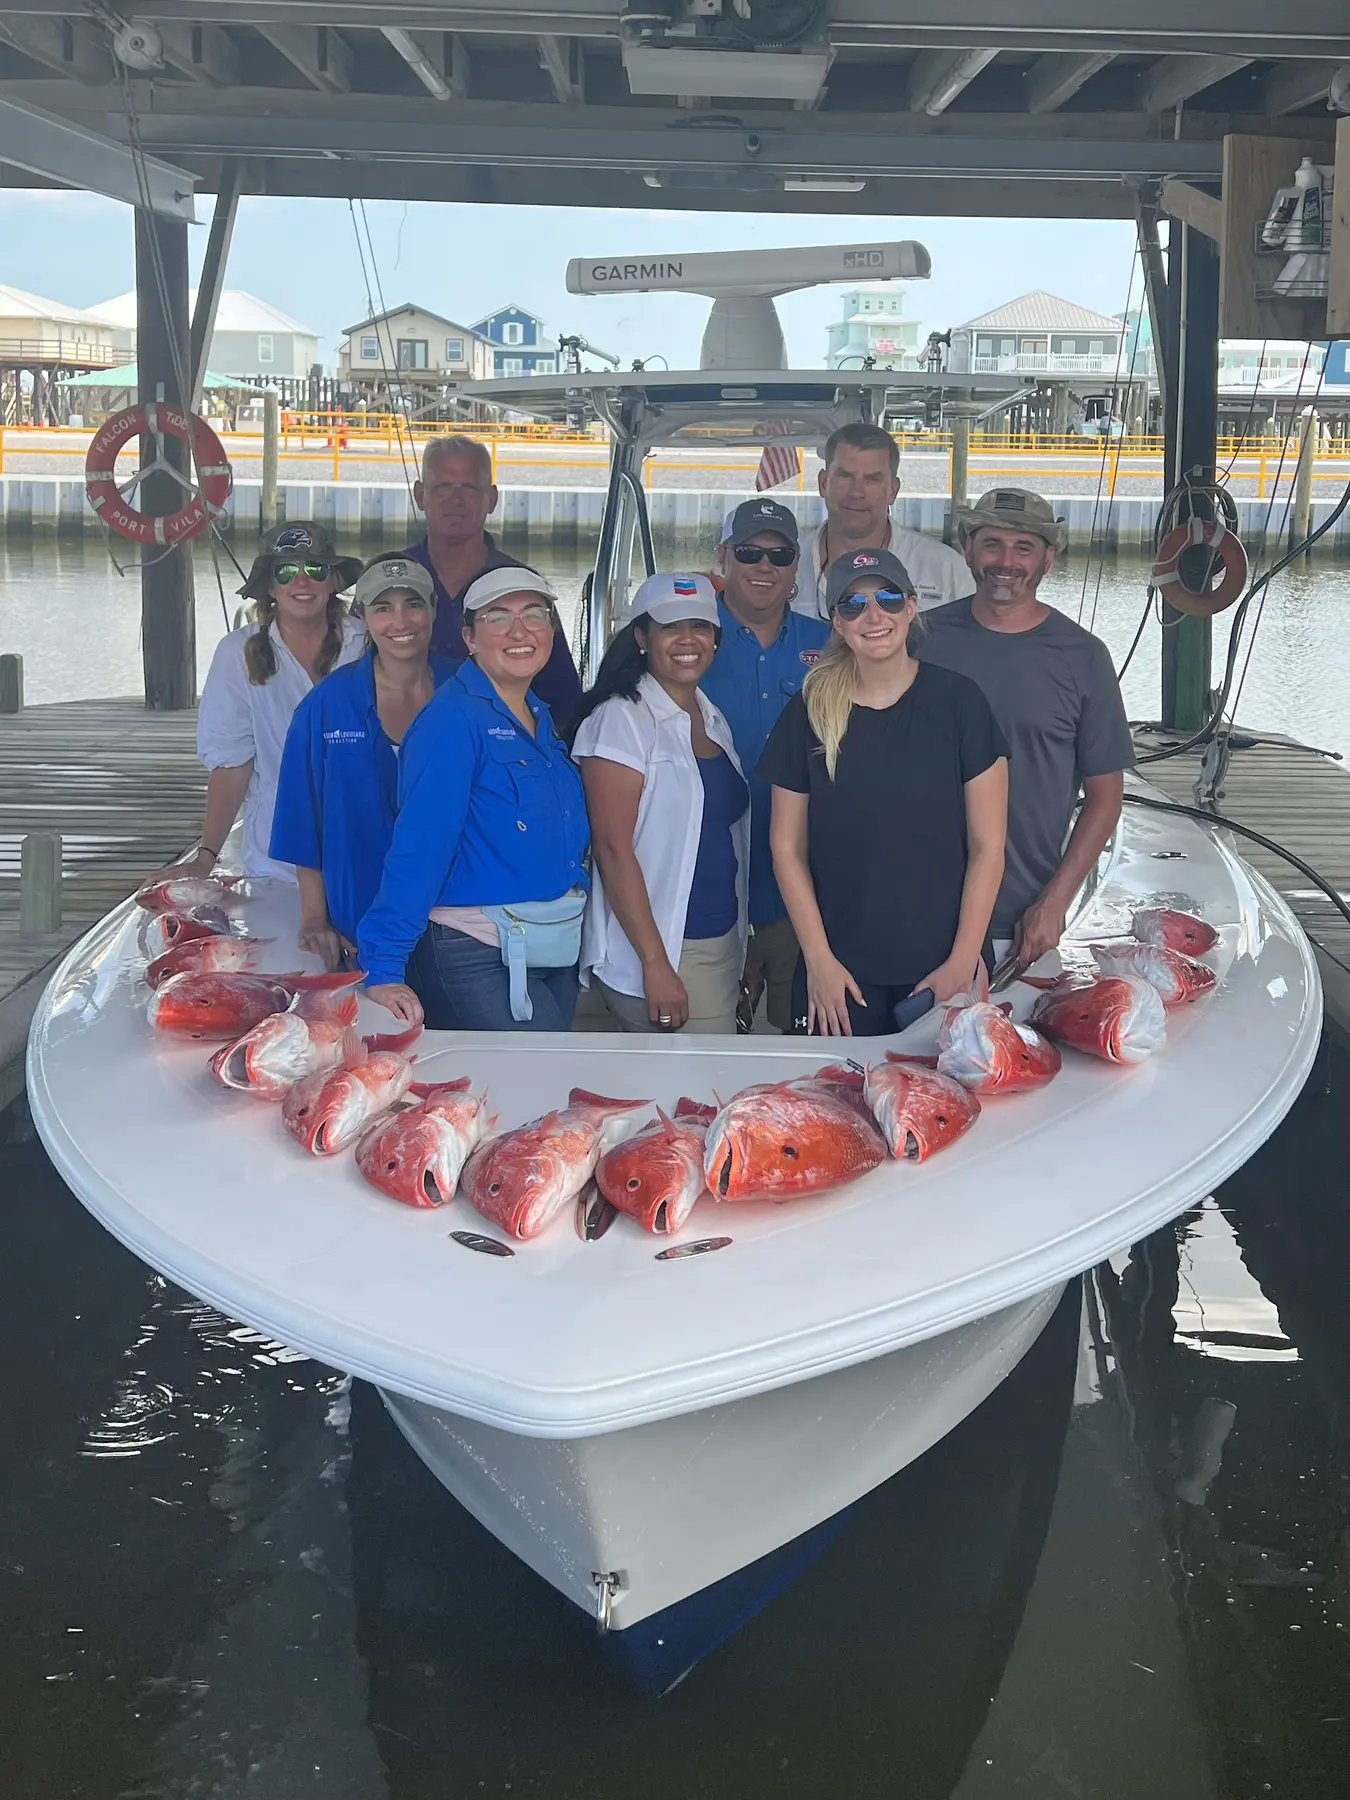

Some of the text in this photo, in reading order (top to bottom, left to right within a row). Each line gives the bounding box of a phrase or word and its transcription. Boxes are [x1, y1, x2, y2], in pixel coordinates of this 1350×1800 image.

[844, 251, 882, 268] xHD
[592, 262, 682, 280] GARMIN
[95, 413, 136, 453] FALCON
[110, 508, 203, 534] PORT VILA
